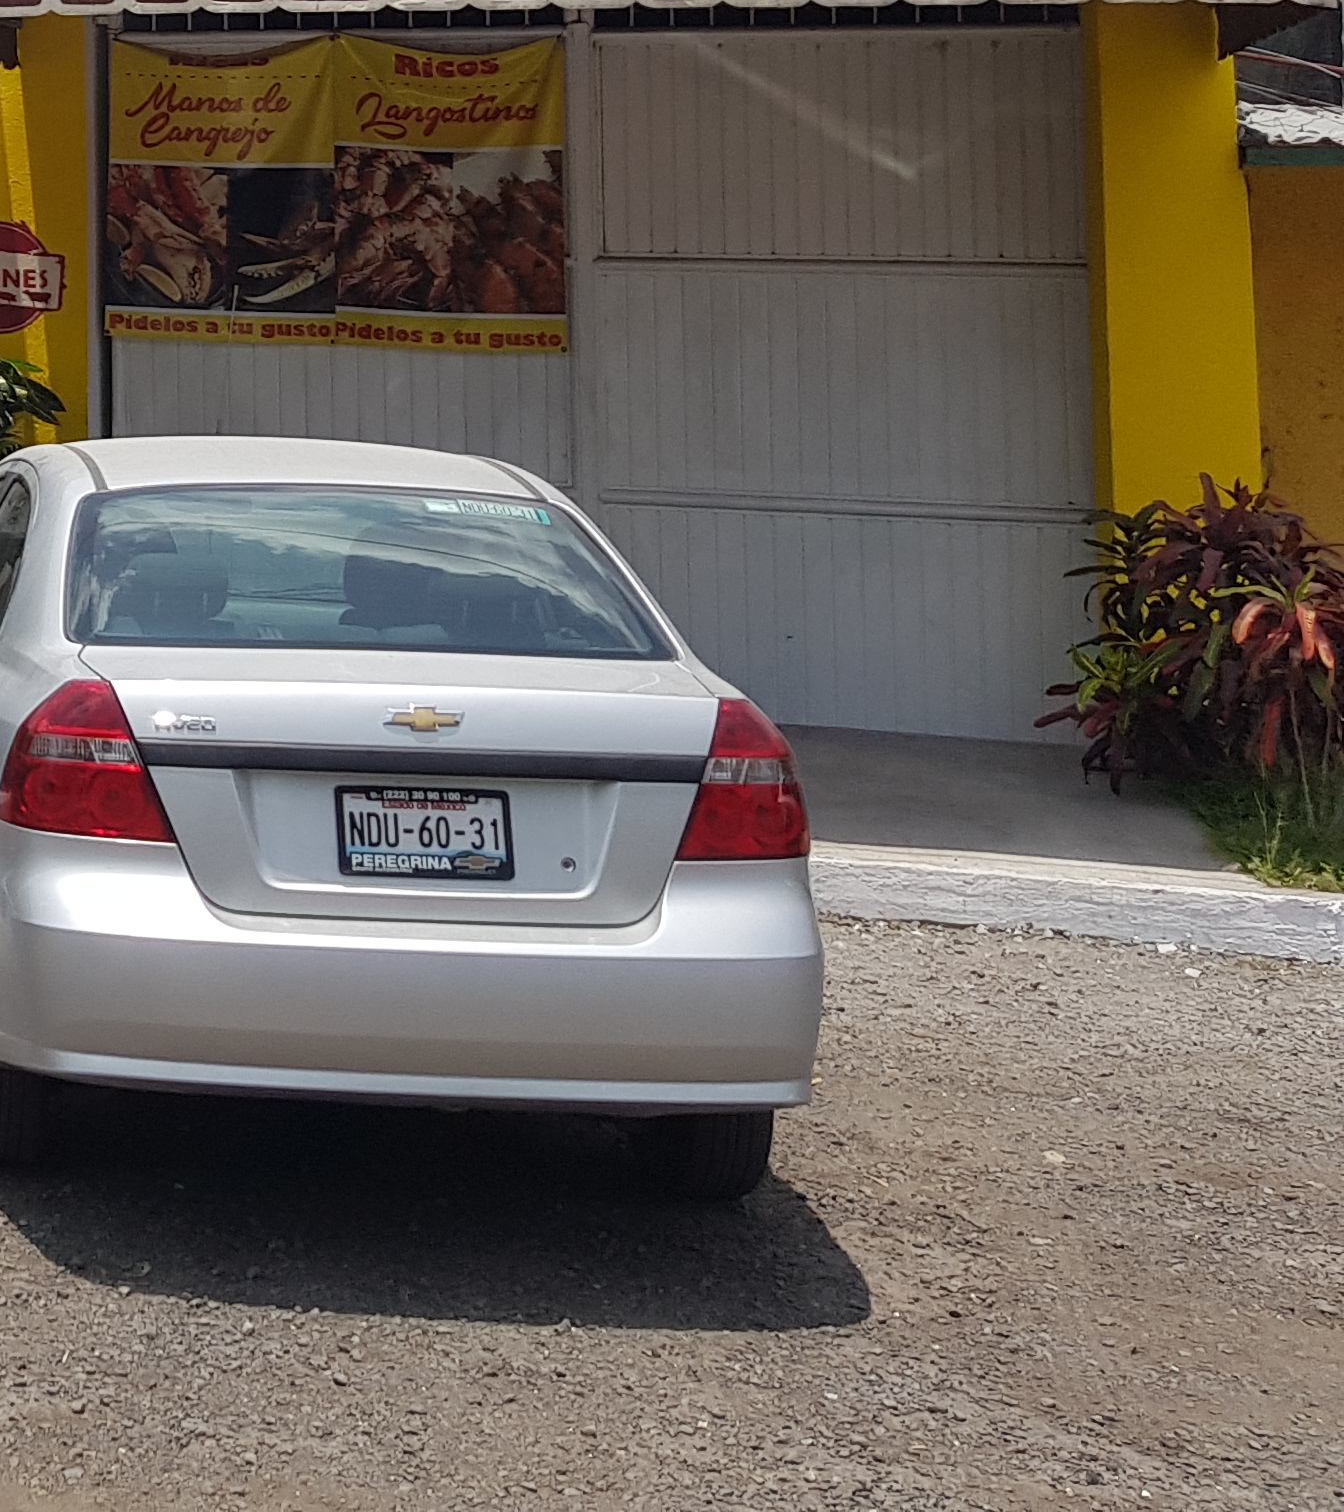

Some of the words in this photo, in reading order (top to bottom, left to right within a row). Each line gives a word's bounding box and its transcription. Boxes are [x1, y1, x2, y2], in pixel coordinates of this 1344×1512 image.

[394, 53, 500, 78] Ricos
[125, 81, 244, 118] Manos
[252, 82, 292, 113] de
[139, 112, 276, 161] Cangrejo
[204, 320, 219, 334] a
[226, 320, 254, 335] tu
[260, 321, 332, 339] gusto
[429, 330, 446, 345] a
[452, 329, 481, 345] tu
[488, 331, 562, 349] gusto
[348, 810, 500, 851] NDU-60-31
[351, 853, 453, 870] PEREGRINA
